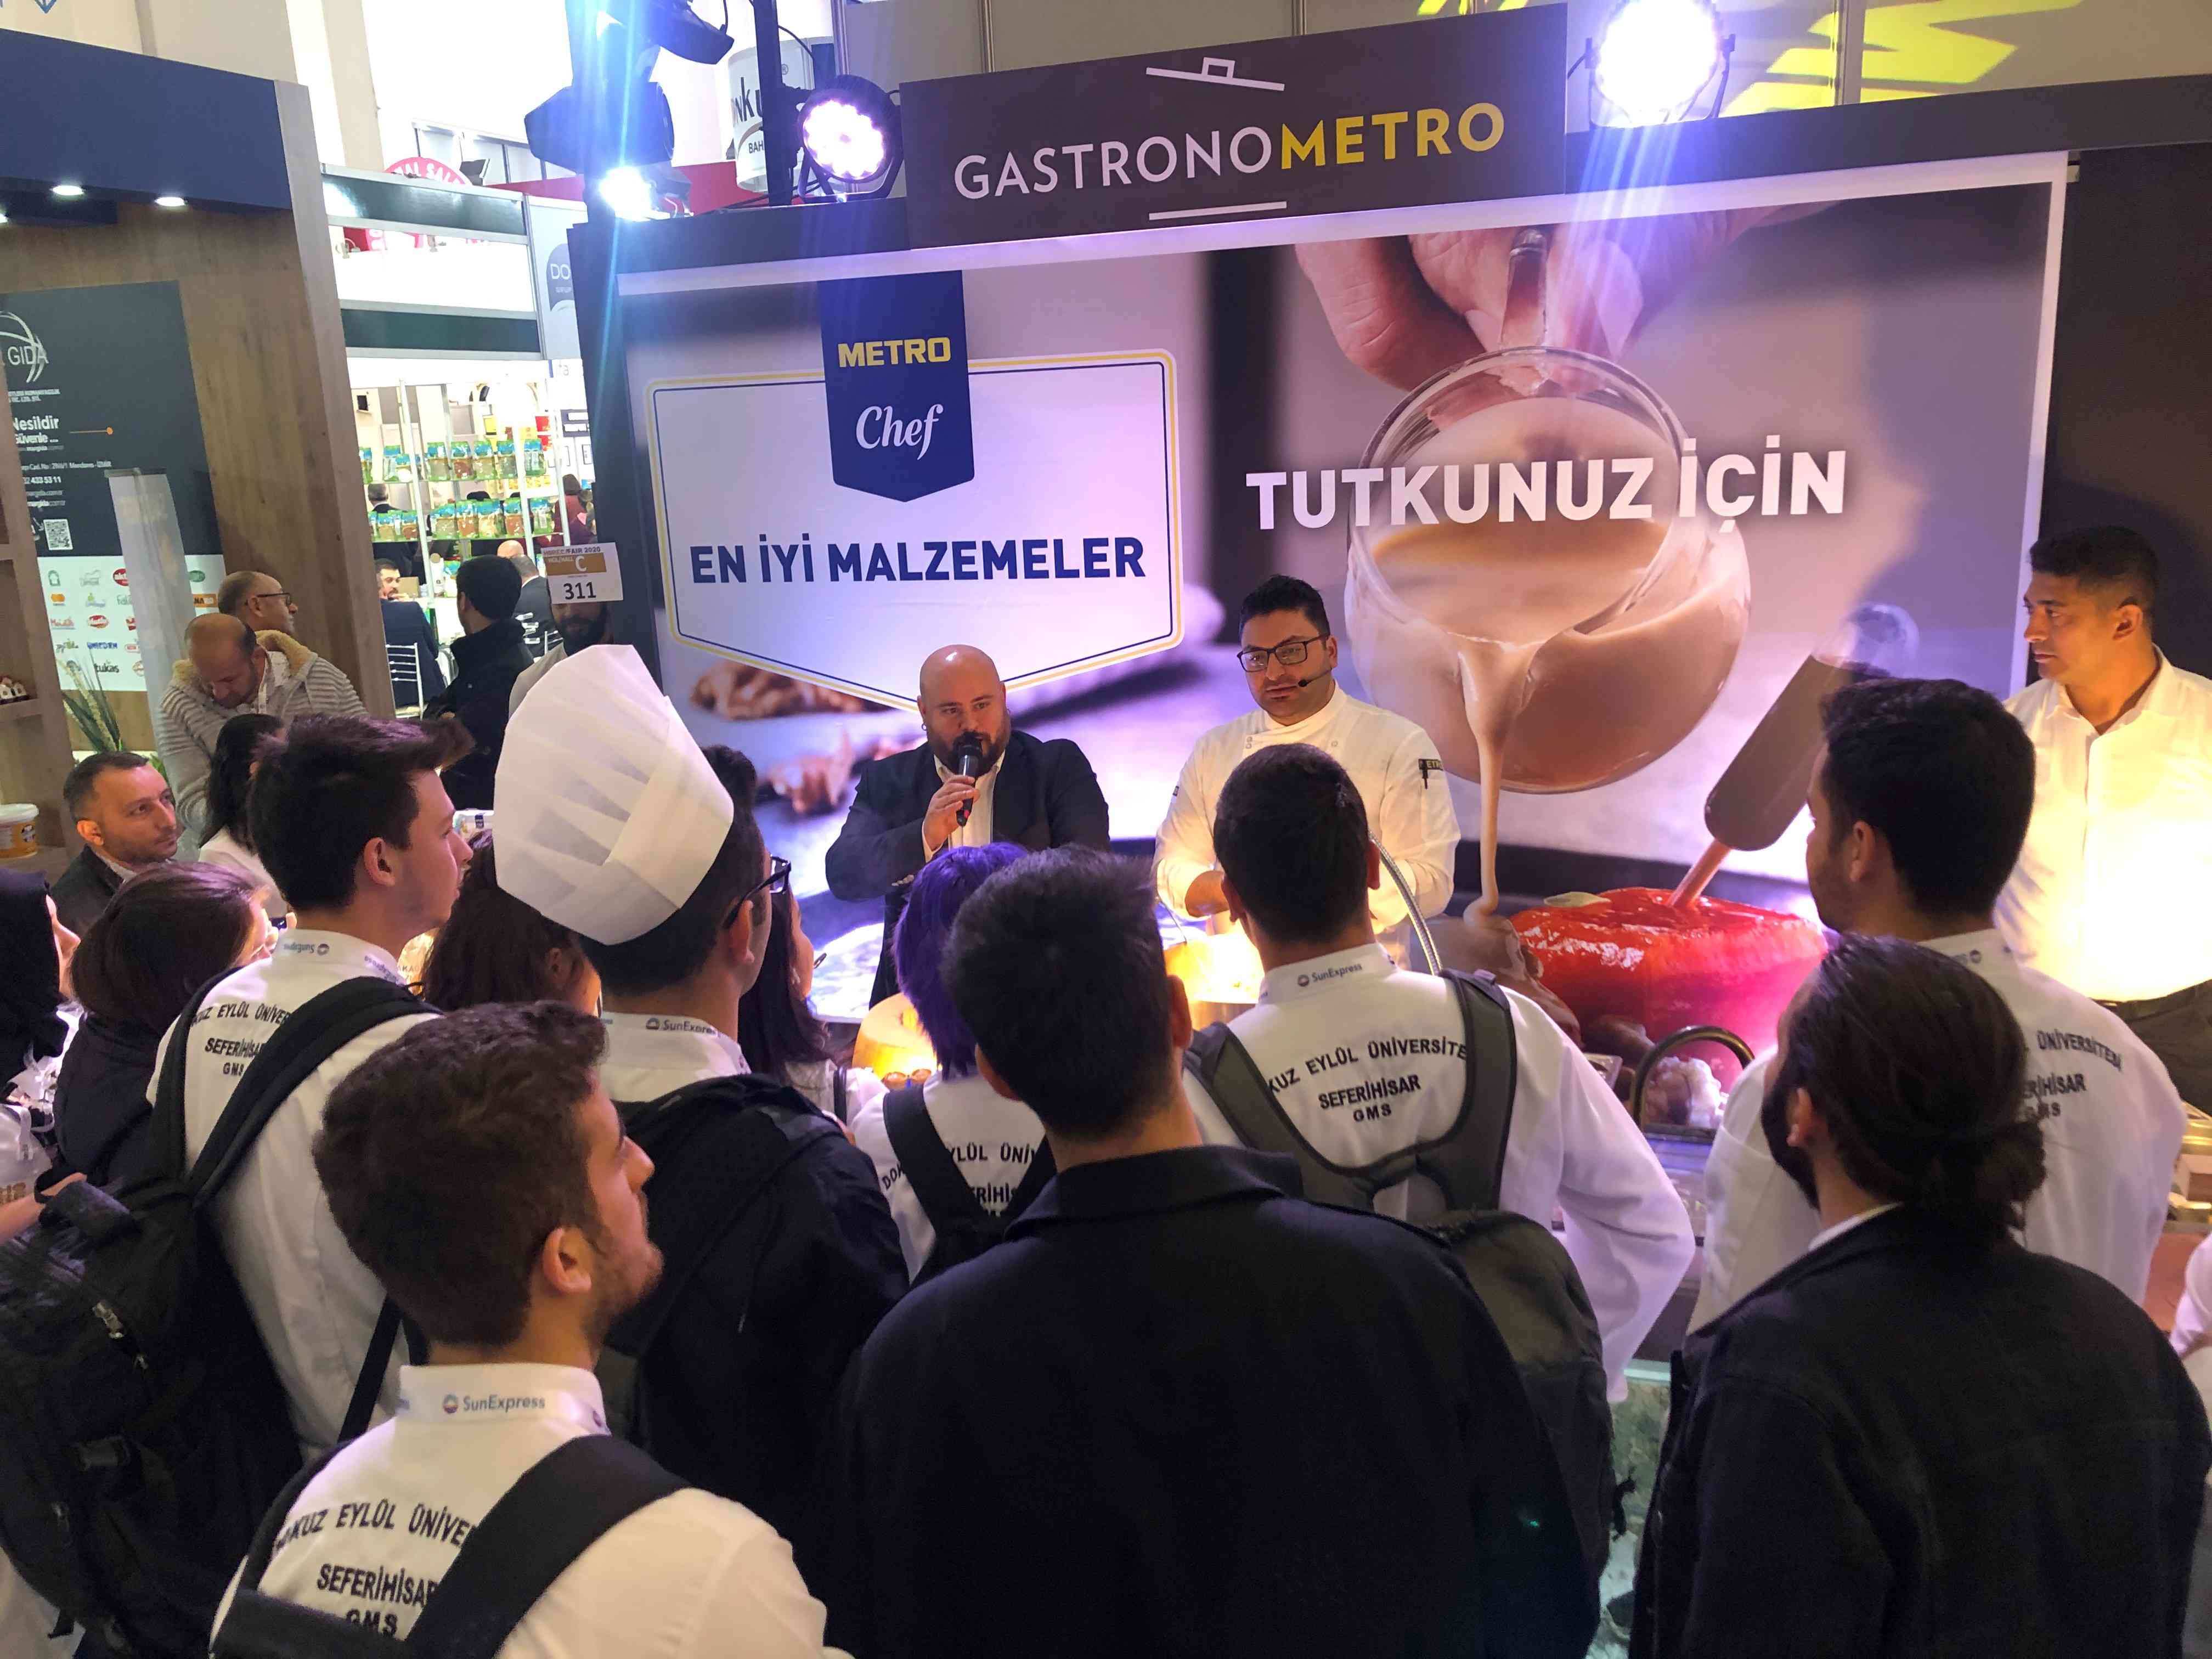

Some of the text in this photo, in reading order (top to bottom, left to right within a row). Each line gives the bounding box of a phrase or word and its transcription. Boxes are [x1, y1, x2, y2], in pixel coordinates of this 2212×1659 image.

[955, 103, 1504, 199] GASTRONOMETRO
[8, 346, 49, 365] GIDA
[838, 337, 951, 368] METRO
[856, 404, 944, 460] Chef
[1245, 435, 1846, 533] TUTKUNUZ İÇİN
[575, 555, 587, 572] C
[690, 533, 1146, 583] EN İYİ MALZEMELER
[563, 582, 596, 600] 311
[1312, 964, 1362, 982] SunExpress
[1305, 1047, 1359, 1076] EYLÜL
[1318, 1074, 1421, 1109] SEFERİHİSAR
[1000, 1142, 1034, 1164] ÜNİ
[970, 1183, 1015, 1203] RİHİ
[463, 1394, 545, 1413] SunExpress
[336, 1498, 396, 1530] EYLÜL
